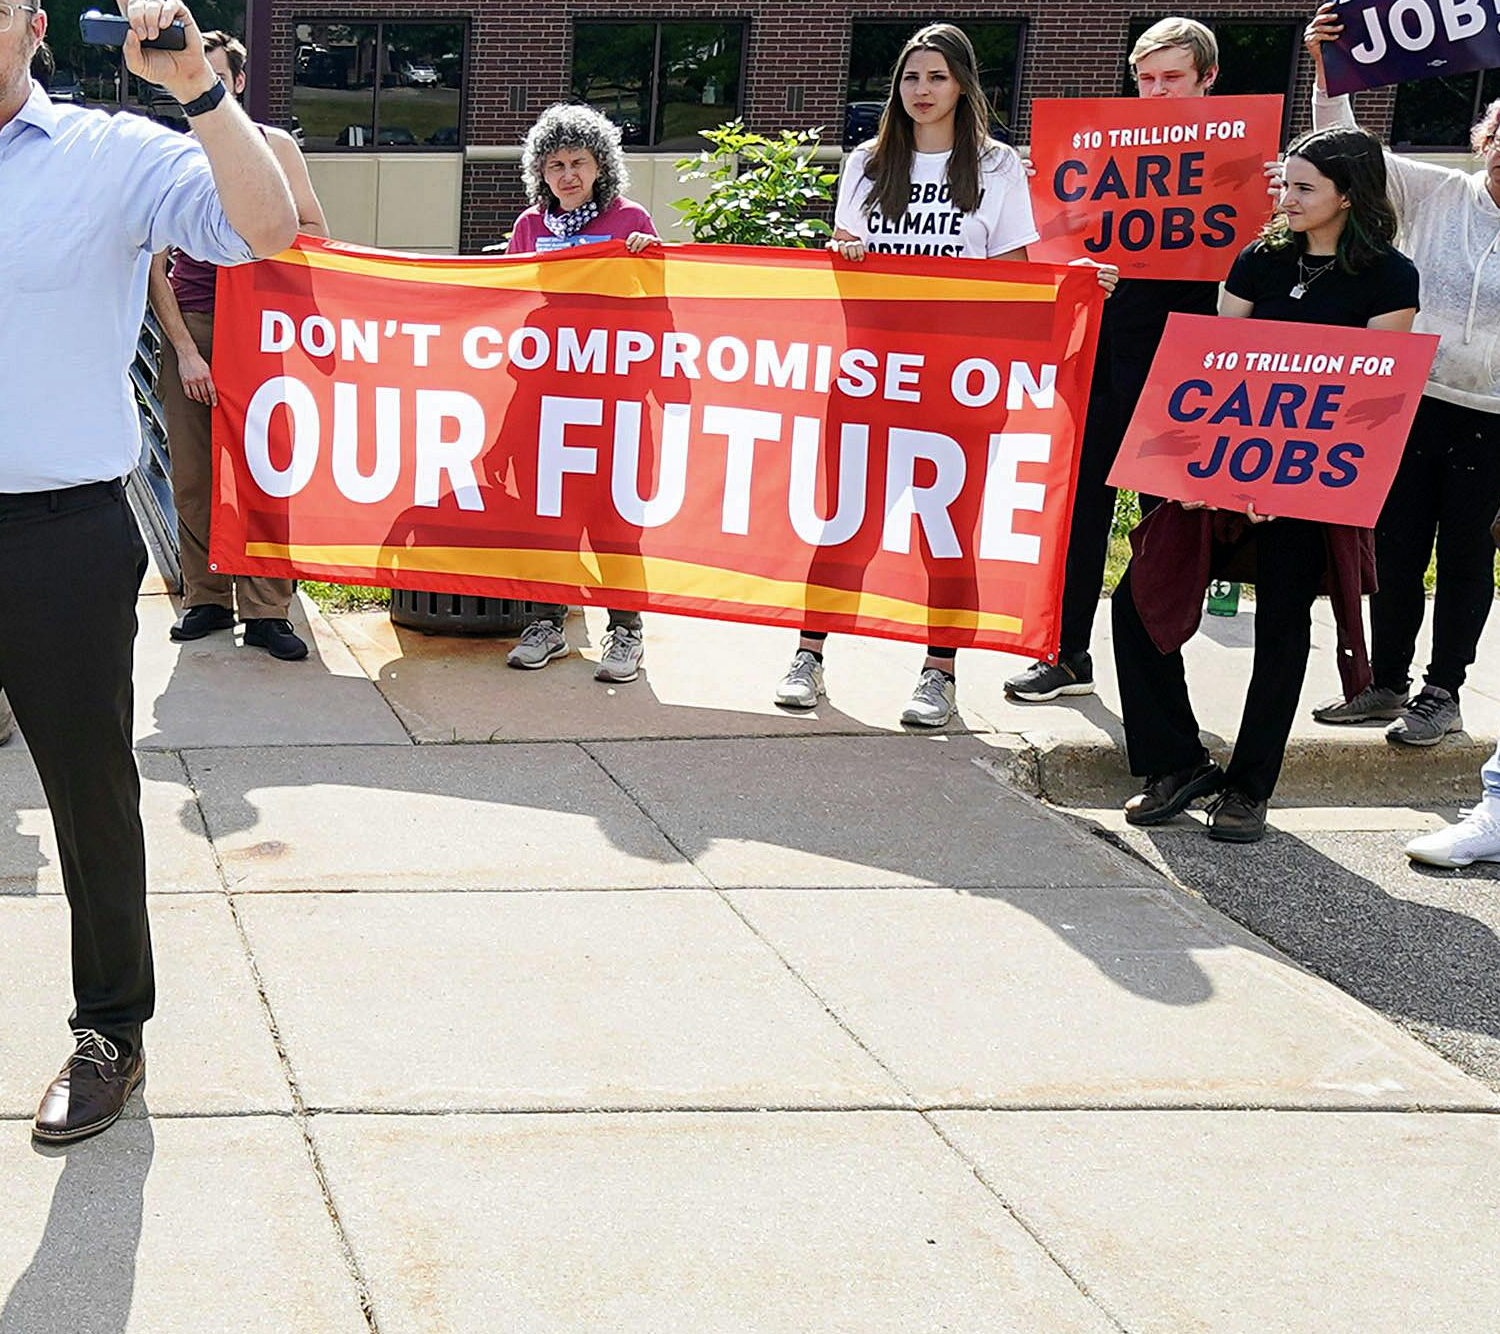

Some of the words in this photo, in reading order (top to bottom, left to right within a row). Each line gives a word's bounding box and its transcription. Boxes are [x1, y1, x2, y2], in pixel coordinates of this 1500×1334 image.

[1073, 131, 1102, 148] $10
[1109, 124, 1198, 146] TRILLION
[1206, 121, 1245, 140] FOR
[1054, 152, 1204, 201] CARE
[867, 211, 964, 236] CLIMATE
[1085, 204, 1236, 252] JOBS
[260, 308, 439, 367] DON'T
[462, 324, 928, 404] COMPROMISE
[952, 358, 1057, 410] ON
[1204, 352, 1238, 369] $10
[1246, 353, 1344, 373] TRILLION
[1350, 357, 1394, 375] FOR
[1169, 380, 1345, 429] CARE
[245, 376, 486, 511] OUR
[535, 394, 1052, 565] FUTURE
[1188, 437, 1364, 487] JOBS
